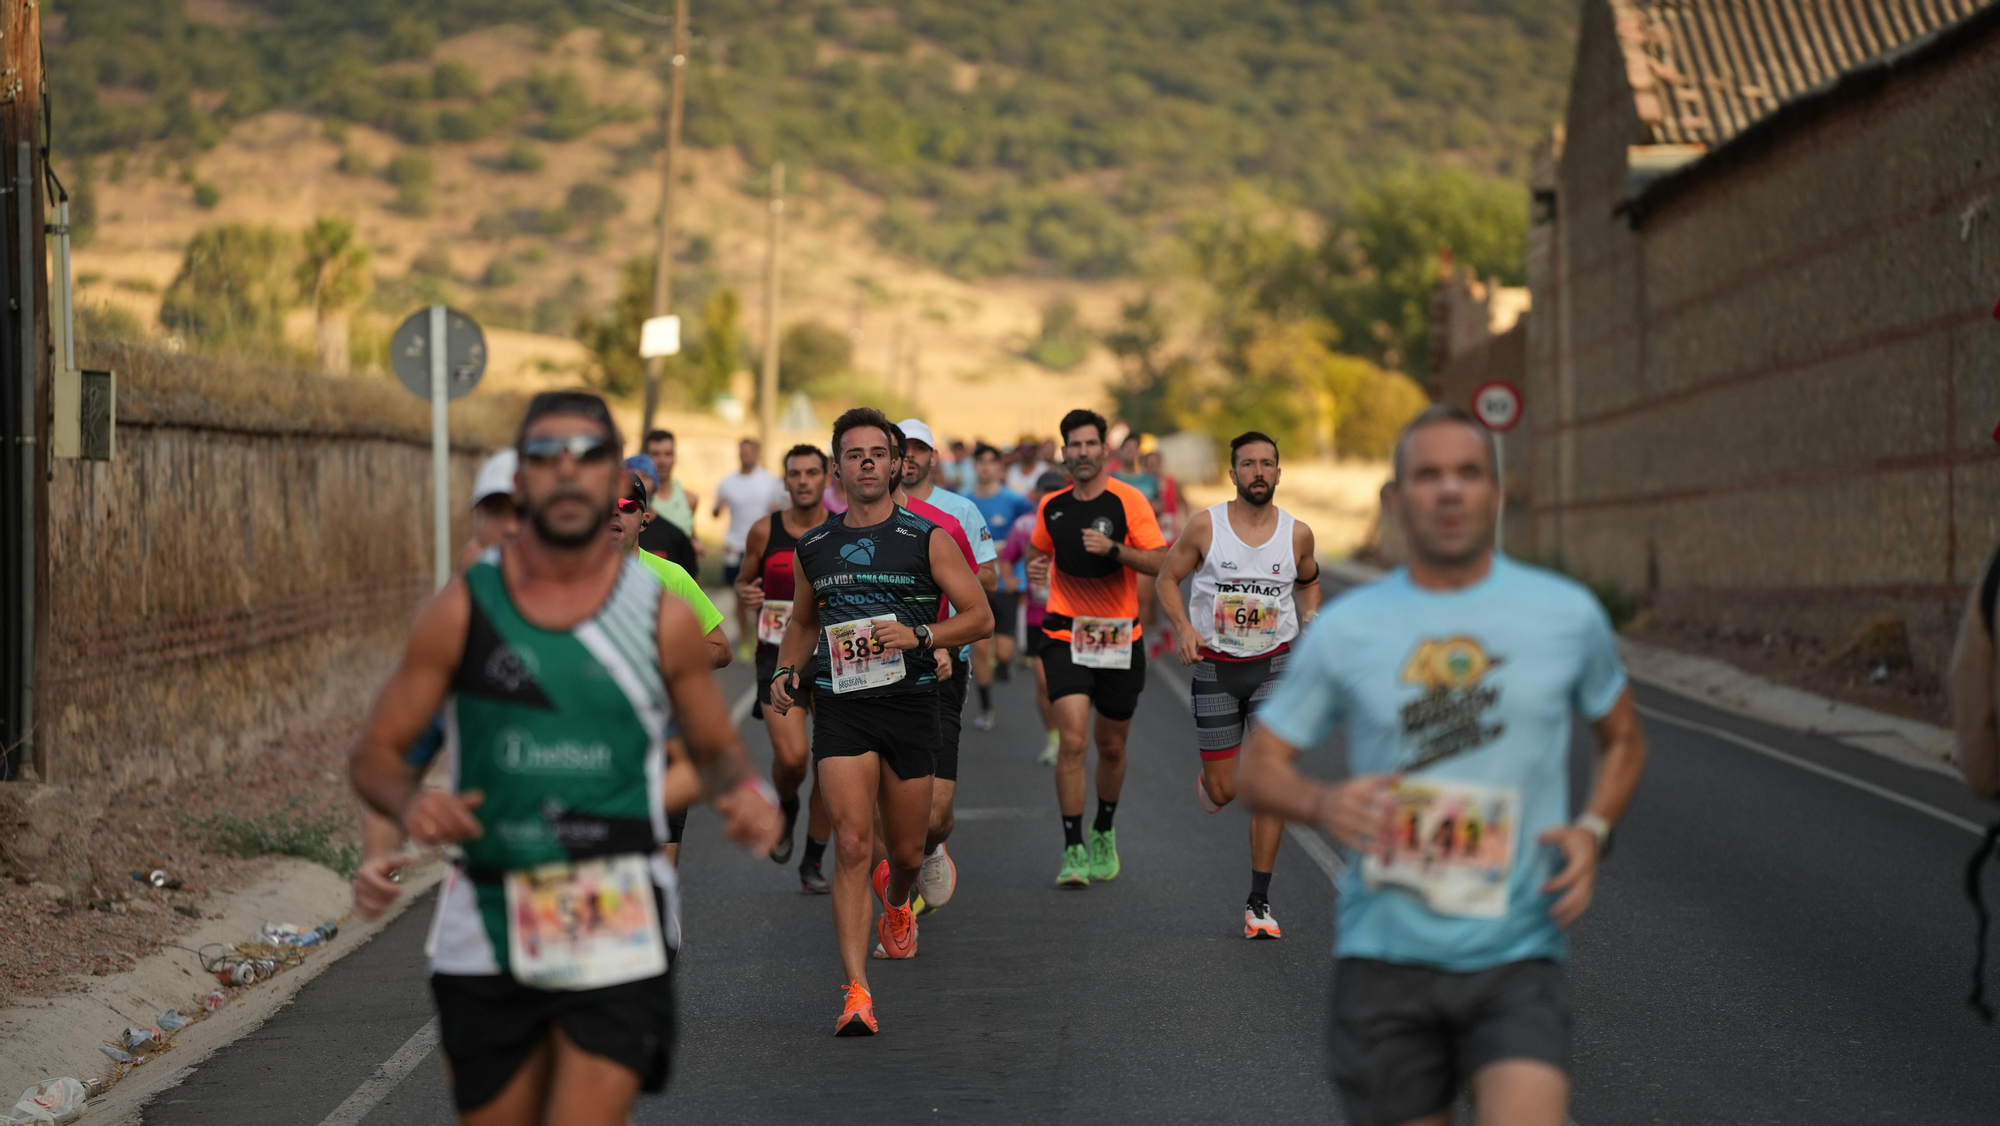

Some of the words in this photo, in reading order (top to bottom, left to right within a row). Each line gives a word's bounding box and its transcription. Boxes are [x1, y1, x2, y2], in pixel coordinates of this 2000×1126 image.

[833, 574, 856, 586] VIDA
[856, 574, 877, 584] DONA
[828, 592, 896, 607] CÓRDOBA
[1235, 608, 1260, 625] 64
[842, 637, 885, 660] 383
